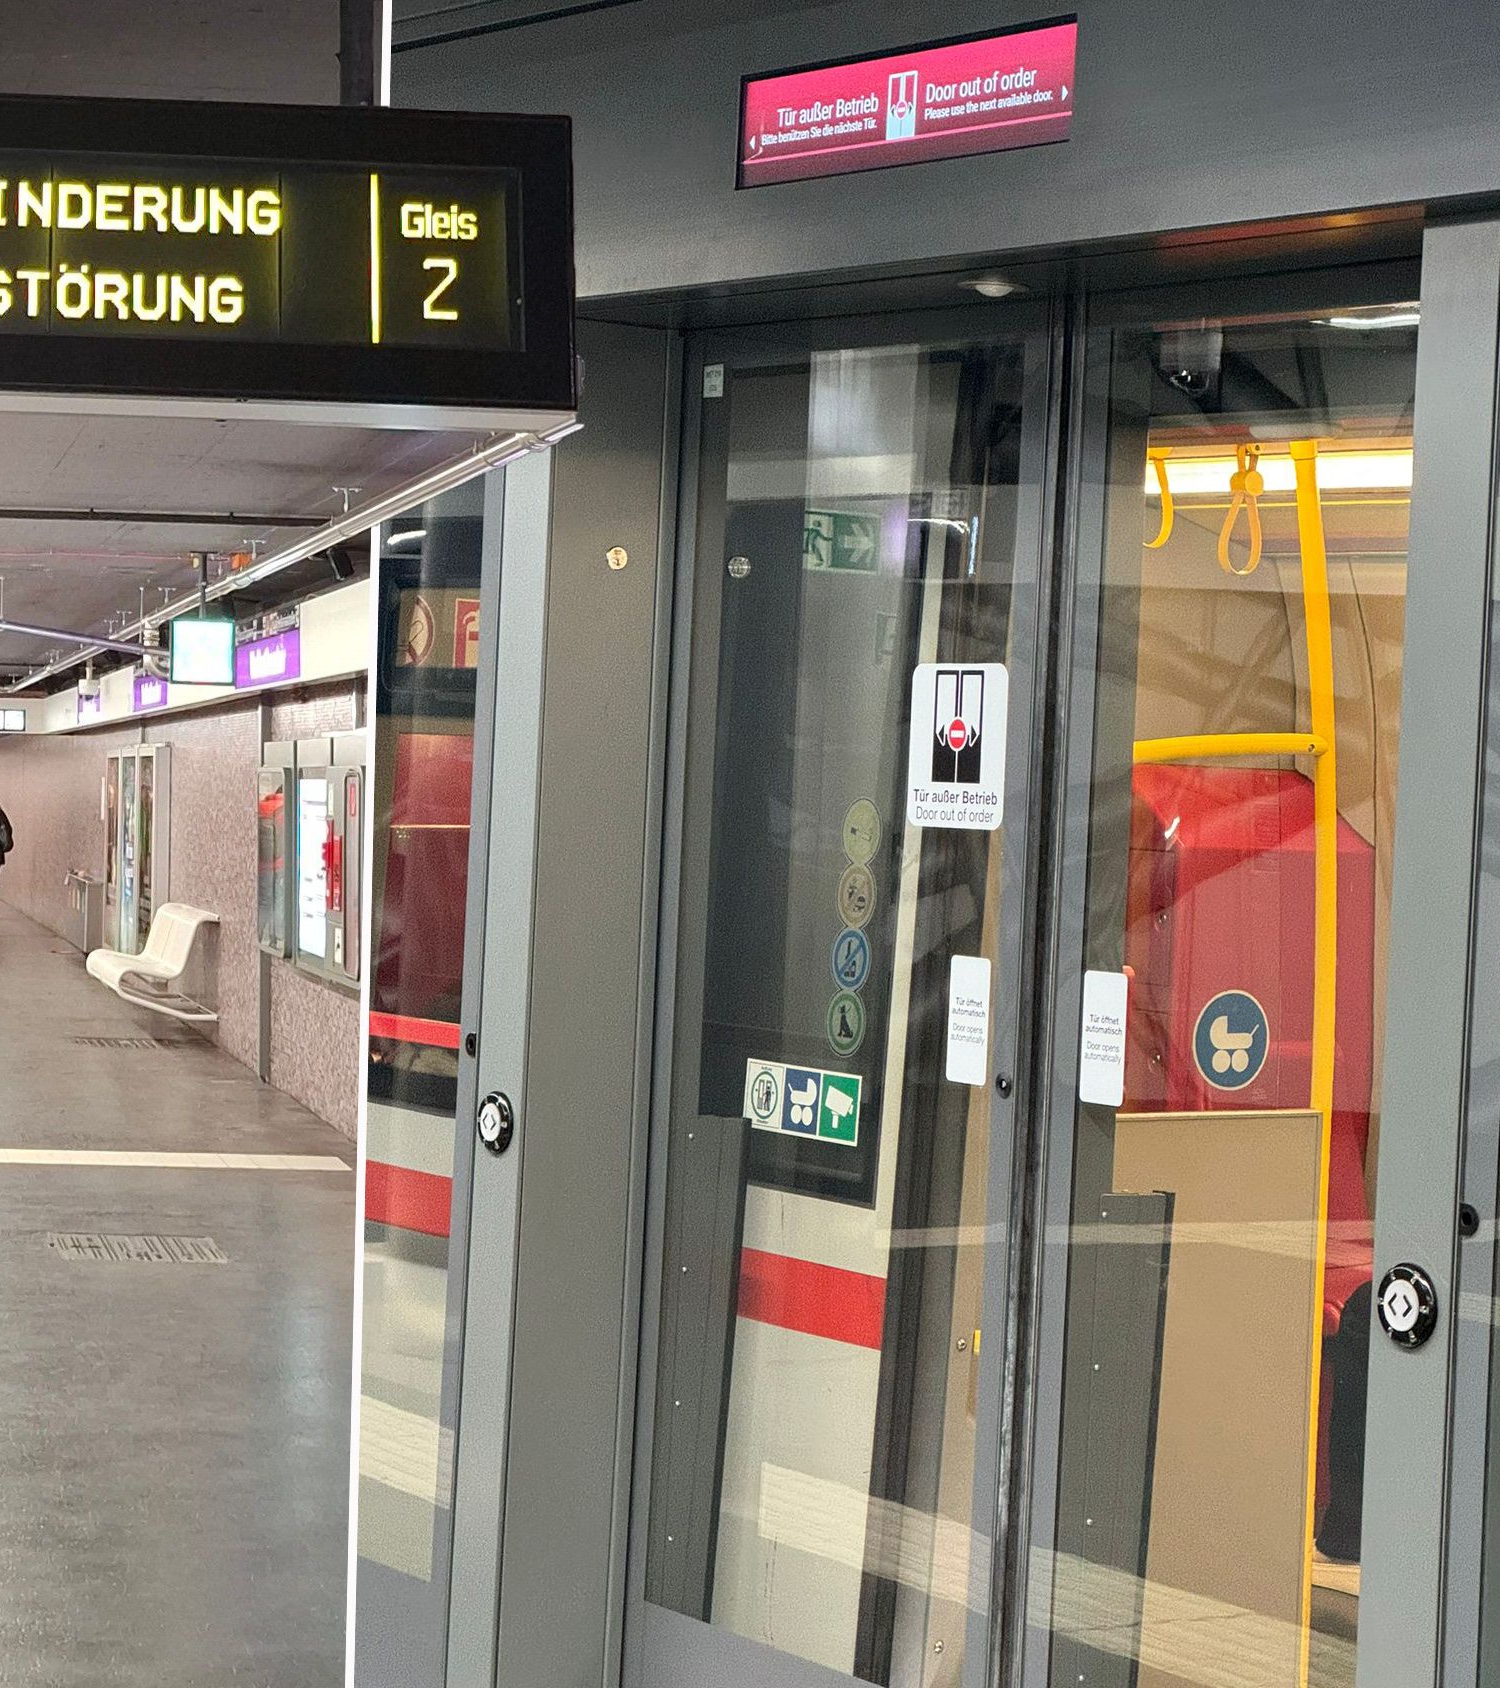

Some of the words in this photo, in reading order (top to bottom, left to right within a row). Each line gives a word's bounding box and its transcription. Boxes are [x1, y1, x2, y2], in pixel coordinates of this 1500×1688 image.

[925, 82, 957, 103] Door
[959, 76, 981, 97] out
[983, 70, 1000, 93] of
[1000, 67, 1037, 91] order
[777, 107, 798, 127] Tür
[798, 101, 835, 124] außer
[835, 92, 879, 118] Betrieb
[924, 106, 950, 120] Please
[950, 104, 966, 116] use
[965, 100, 979, 113] the
[979, 97, 997, 111] next
[997, 91, 1033, 109] available
[1032, 89, 1054, 103] door.
[810, 126, 822, 138] Sie
[822, 124, 835, 136] die
[399, 202, 479, 241] Gleis
[421, 257, 460, 321] 2
[913, 788, 929, 802] Tür
[931, 790, 959, 803] außer
[962, 790, 998, 805] Betrieb
[916, 805, 938, 820] Door
[940, 809, 955, 821] out
[957, 808, 967, 821] of
[969, 809, 994, 823] order
